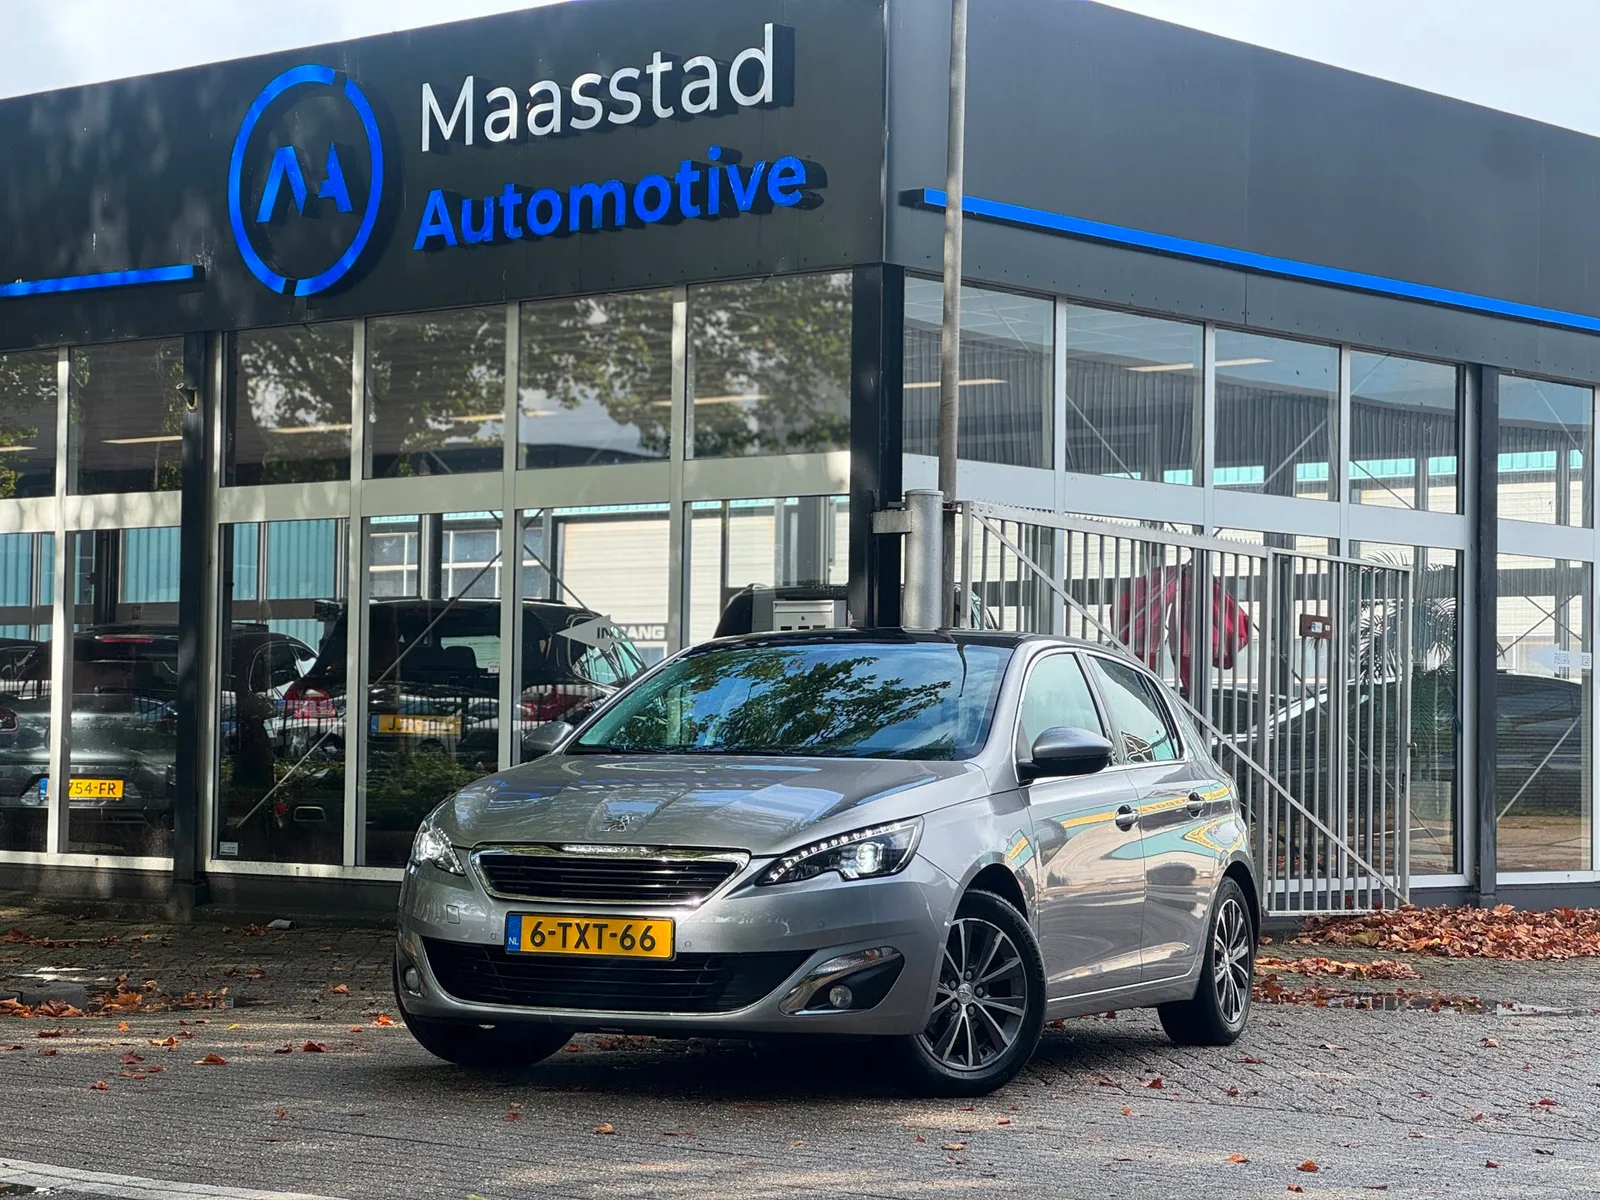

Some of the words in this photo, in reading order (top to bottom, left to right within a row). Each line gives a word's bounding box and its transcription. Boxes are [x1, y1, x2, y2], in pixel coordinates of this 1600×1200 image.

[421, 22, 773, 152] Maasstad
[413, 144, 807, 251] Automotive
[508, 936, 520, 946] NL
[529, 920, 656, 952] 6-TXT-66
